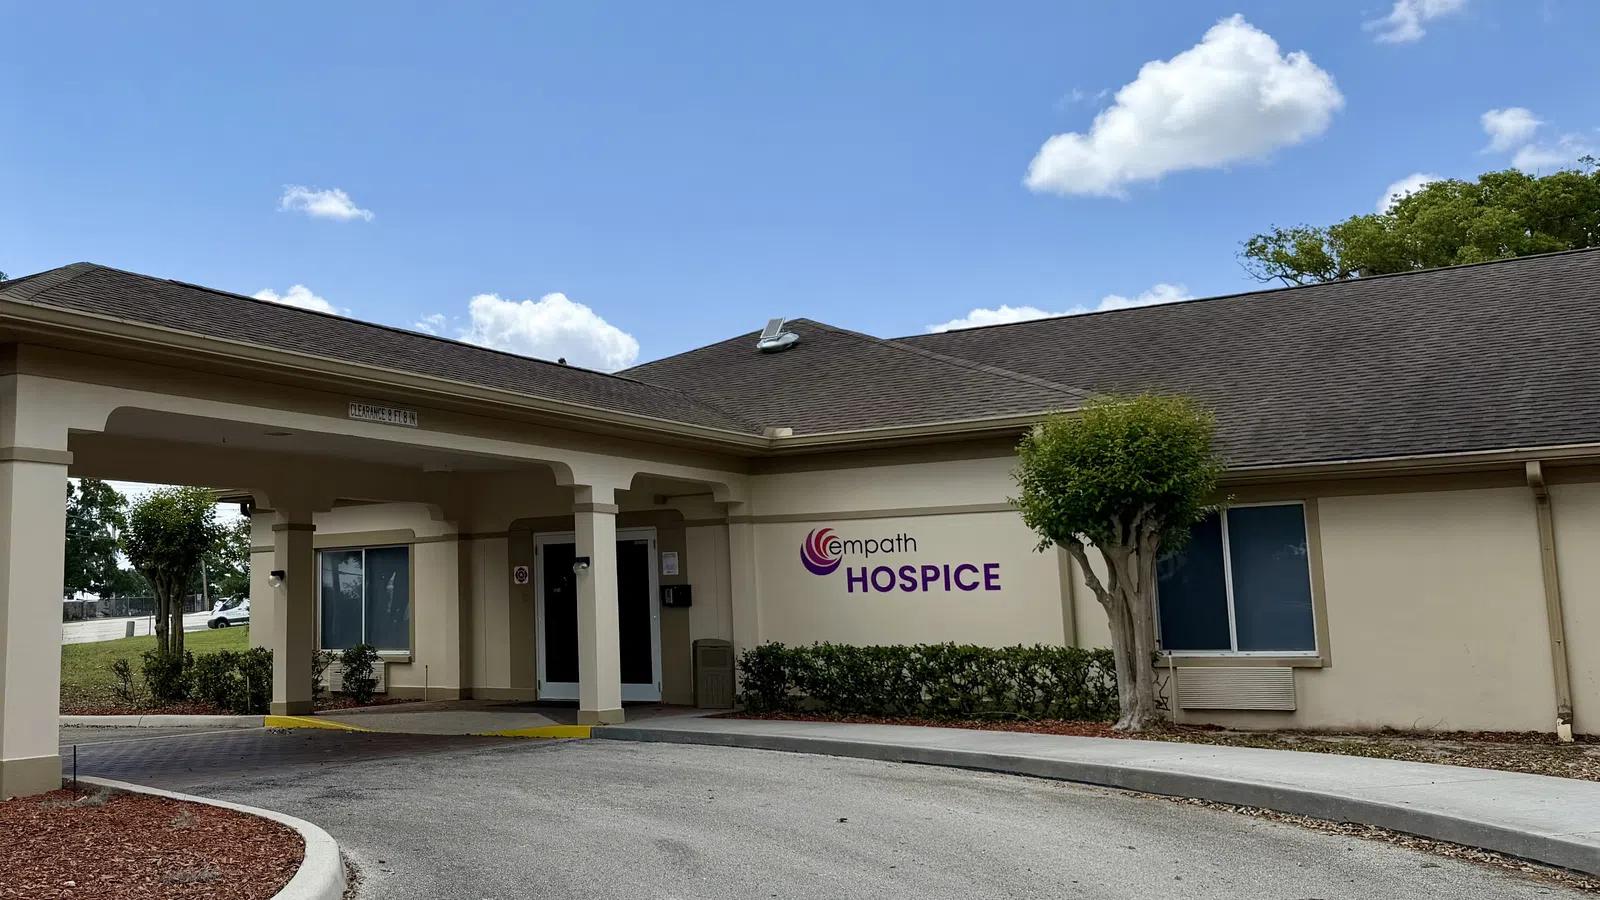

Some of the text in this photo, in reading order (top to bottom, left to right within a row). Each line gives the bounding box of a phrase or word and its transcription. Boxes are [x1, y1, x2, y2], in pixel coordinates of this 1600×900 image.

[350, 403, 386, 421] CLEARANCE
[387, 409, 392, 421] 8
[403, 411, 408, 423] 8
[828, 533, 917, 558] empath
[846, 563, 1001, 593] HOSPICE
